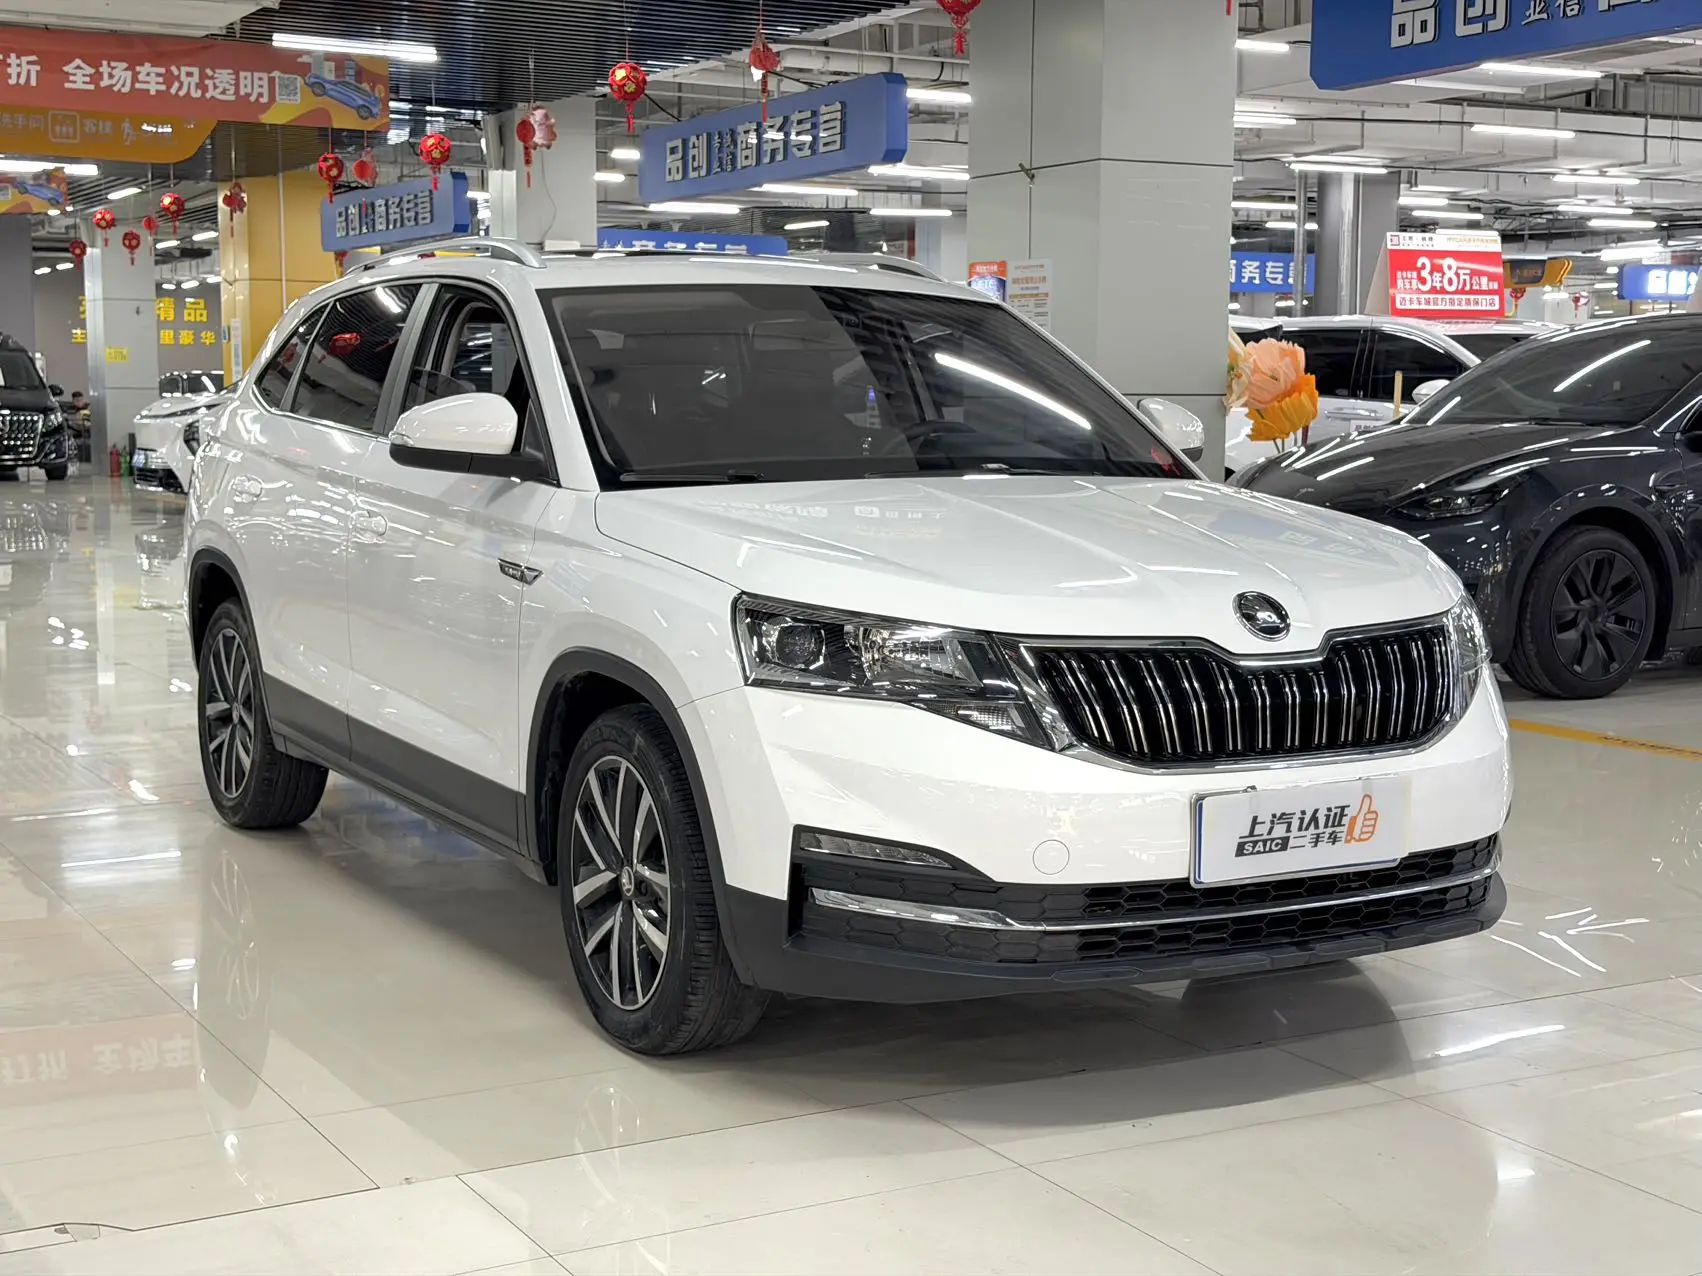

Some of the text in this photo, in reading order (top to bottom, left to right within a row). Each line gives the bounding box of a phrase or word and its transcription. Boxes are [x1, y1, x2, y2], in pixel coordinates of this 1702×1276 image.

[0, 53, 270, 104] 折 全场车况透明
[1239, 804, 1351, 840] 上汽认证
[1242, 830, 1345, 855] SAIC 二手车
